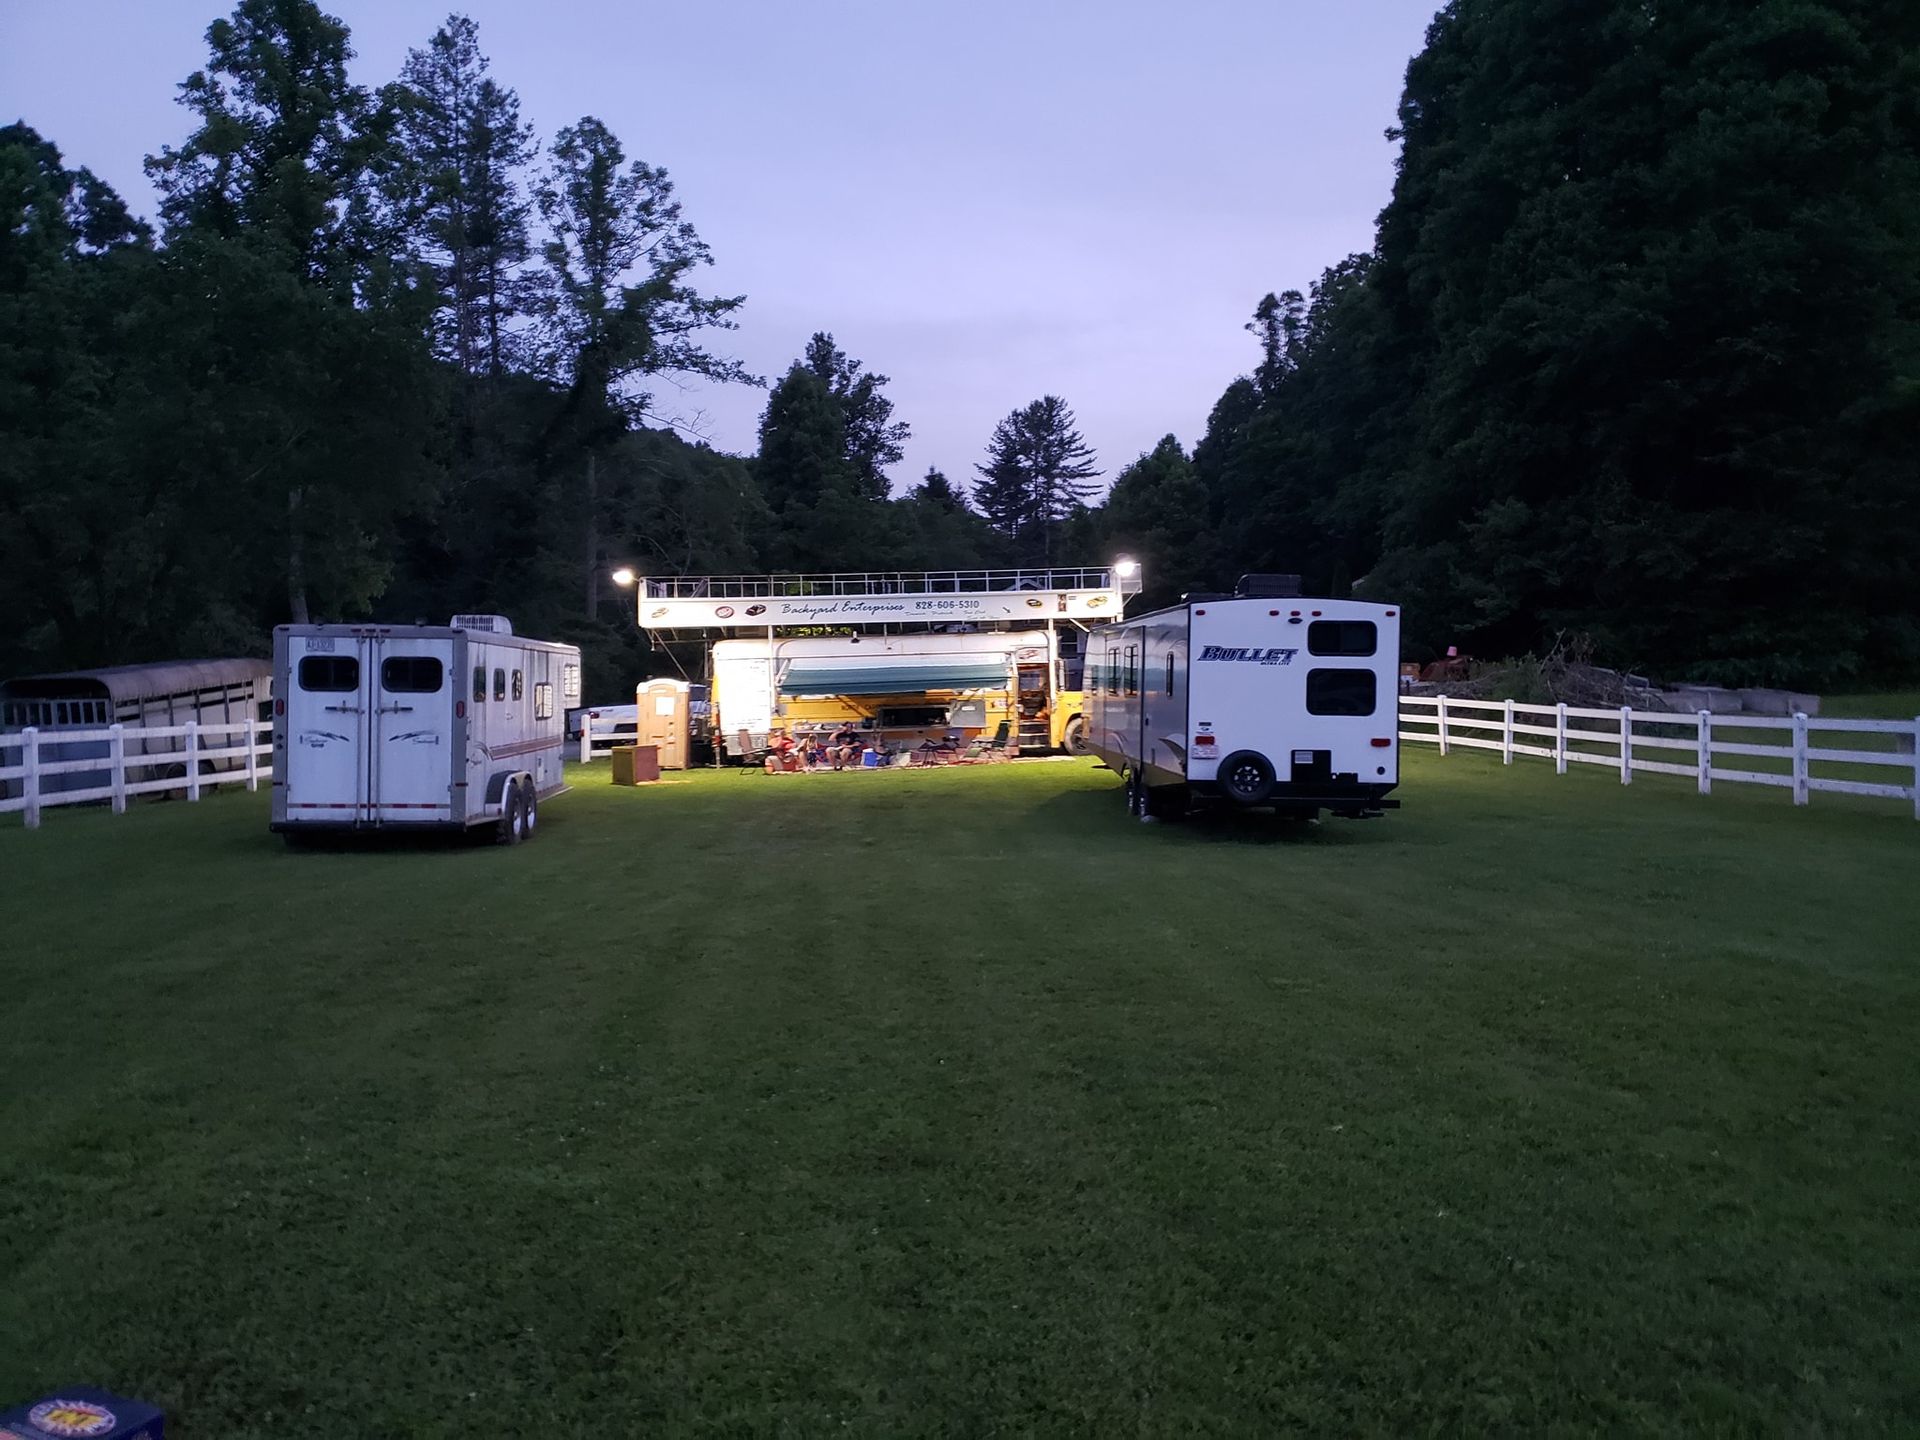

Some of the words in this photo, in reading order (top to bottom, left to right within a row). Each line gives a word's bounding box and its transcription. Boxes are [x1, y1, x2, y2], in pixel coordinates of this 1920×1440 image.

[781, 602, 838, 620] Backyard
[841, 600, 905, 615] Enterprises
[915, 600, 980, 610] 828-606-5310
[1197, 645, 1299, 661] BULLET
